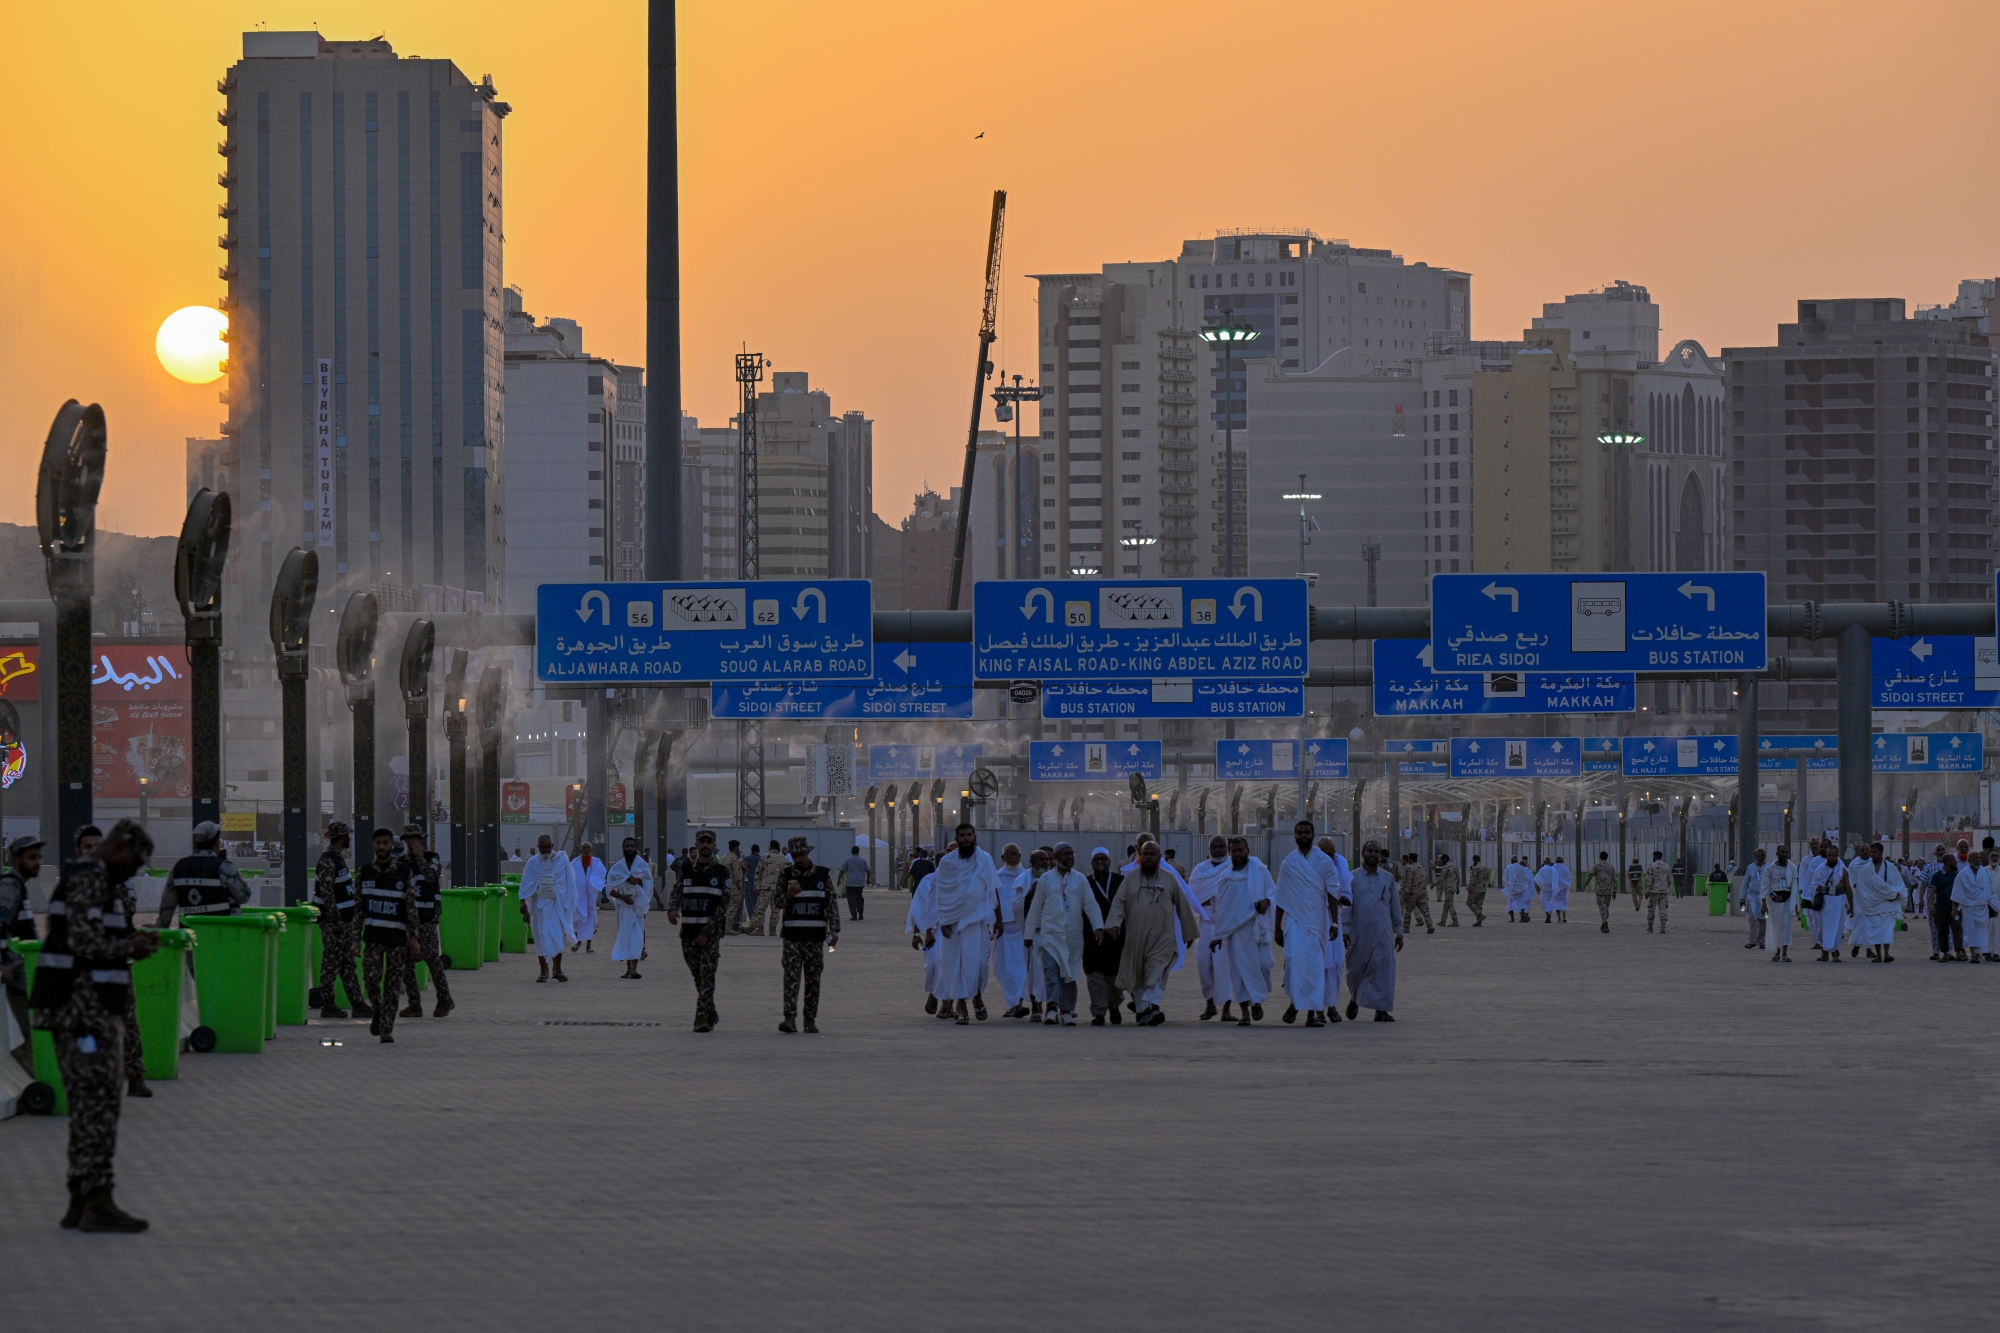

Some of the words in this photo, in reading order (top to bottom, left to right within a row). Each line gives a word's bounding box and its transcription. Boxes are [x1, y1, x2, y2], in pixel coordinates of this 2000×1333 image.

[319, 363, 329, 447] BEYRUHA
[631, 613, 650, 625] 56
[757, 611, 776, 623] 62
[1070, 611, 1086, 624] 50
[1196, 610, 1212, 623] 38
[1448, 625, 1508, 651] صدقي
[1632, 624, 1701, 640] حافلات
[1707, 626, 1759, 640] محطة
[557, 635, 623, 655] الجوهرة
[629, 636, 671, 655] طريق
[720, 635, 771, 653] العرب
[778, 634, 816, 652] سوق
[821, 634, 864, 653] طريق
[980, 632, 1028, 653] فيصل
[1031, 633, 1073, 649] الملك
[1077, 634, 1119, 653] طريق
[1214, 632, 1256, 647] الملك
[1260, 632, 1302, 651] طريق
[1516, 633, 1548, 649] ريع
[980, 658, 1012, 672] KING
[1018, 658, 1072, 671] FAISAL
[1168, 657, 1215, 670] ABDEL
[1222, 657, 1256, 670] AZIZ
[1262, 656, 1302, 669] ROAD
[1457, 654, 1493, 665] RIEA
[1499, 653, 1539, 666] SIDQI
[1650, 651, 1678, 664] BUS
[1684, 650, 1743, 664] STATION
[548, 662, 638, 674] ALJAWHARA
[645, 662, 681, 674] ROAD
[720, 660, 757, 673] SOUQ
[763, 660, 822, 672] ALARAB
[830, 659, 866, 671] ROAD
[1447, 679, 1468, 691] مكة
[1541, 677, 1589, 692] المكرمة
[1596, 676, 1620, 688] مكة
[1885, 669, 1926, 691] صدقي
[1929, 671, 1958, 687] شارع
[865, 677, 908, 696] صدقي
[910, 680, 942, 697] شارع
[1100, 683, 1148, 694] محطة
[1198, 681, 1252, 694] حافلات
[1257, 682, 1298, 693] محطة
[1390, 680, 1438, 696] المكرمة
[1548, 696, 1613, 707] MAKKAH
[1881, 693, 1913, 702] SIDQI
[1918, 692, 1964, 702] STREET
[739, 702, 773, 714] SIDQI
[774, 701, 822, 713] STREET
[863, 702, 896, 712] SIDQI
[900, 703, 948, 714] STREET
[1061, 703, 1083, 713] BUS
[1088, 703, 1134, 713] STATION
[1211, 702, 1234, 712] BUS
[1238, 702, 1285, 712] STATION
[1396, 699, 1464, 710] MAKKAH
[1226, 759, 1242, 768] الحج
[1245, 758, 1263, 768] شارع
[1651, 756, 1668, 765] شارع
[369, 899, 398, 915] POLICE
[792, 903, 820, 914] POLICE
